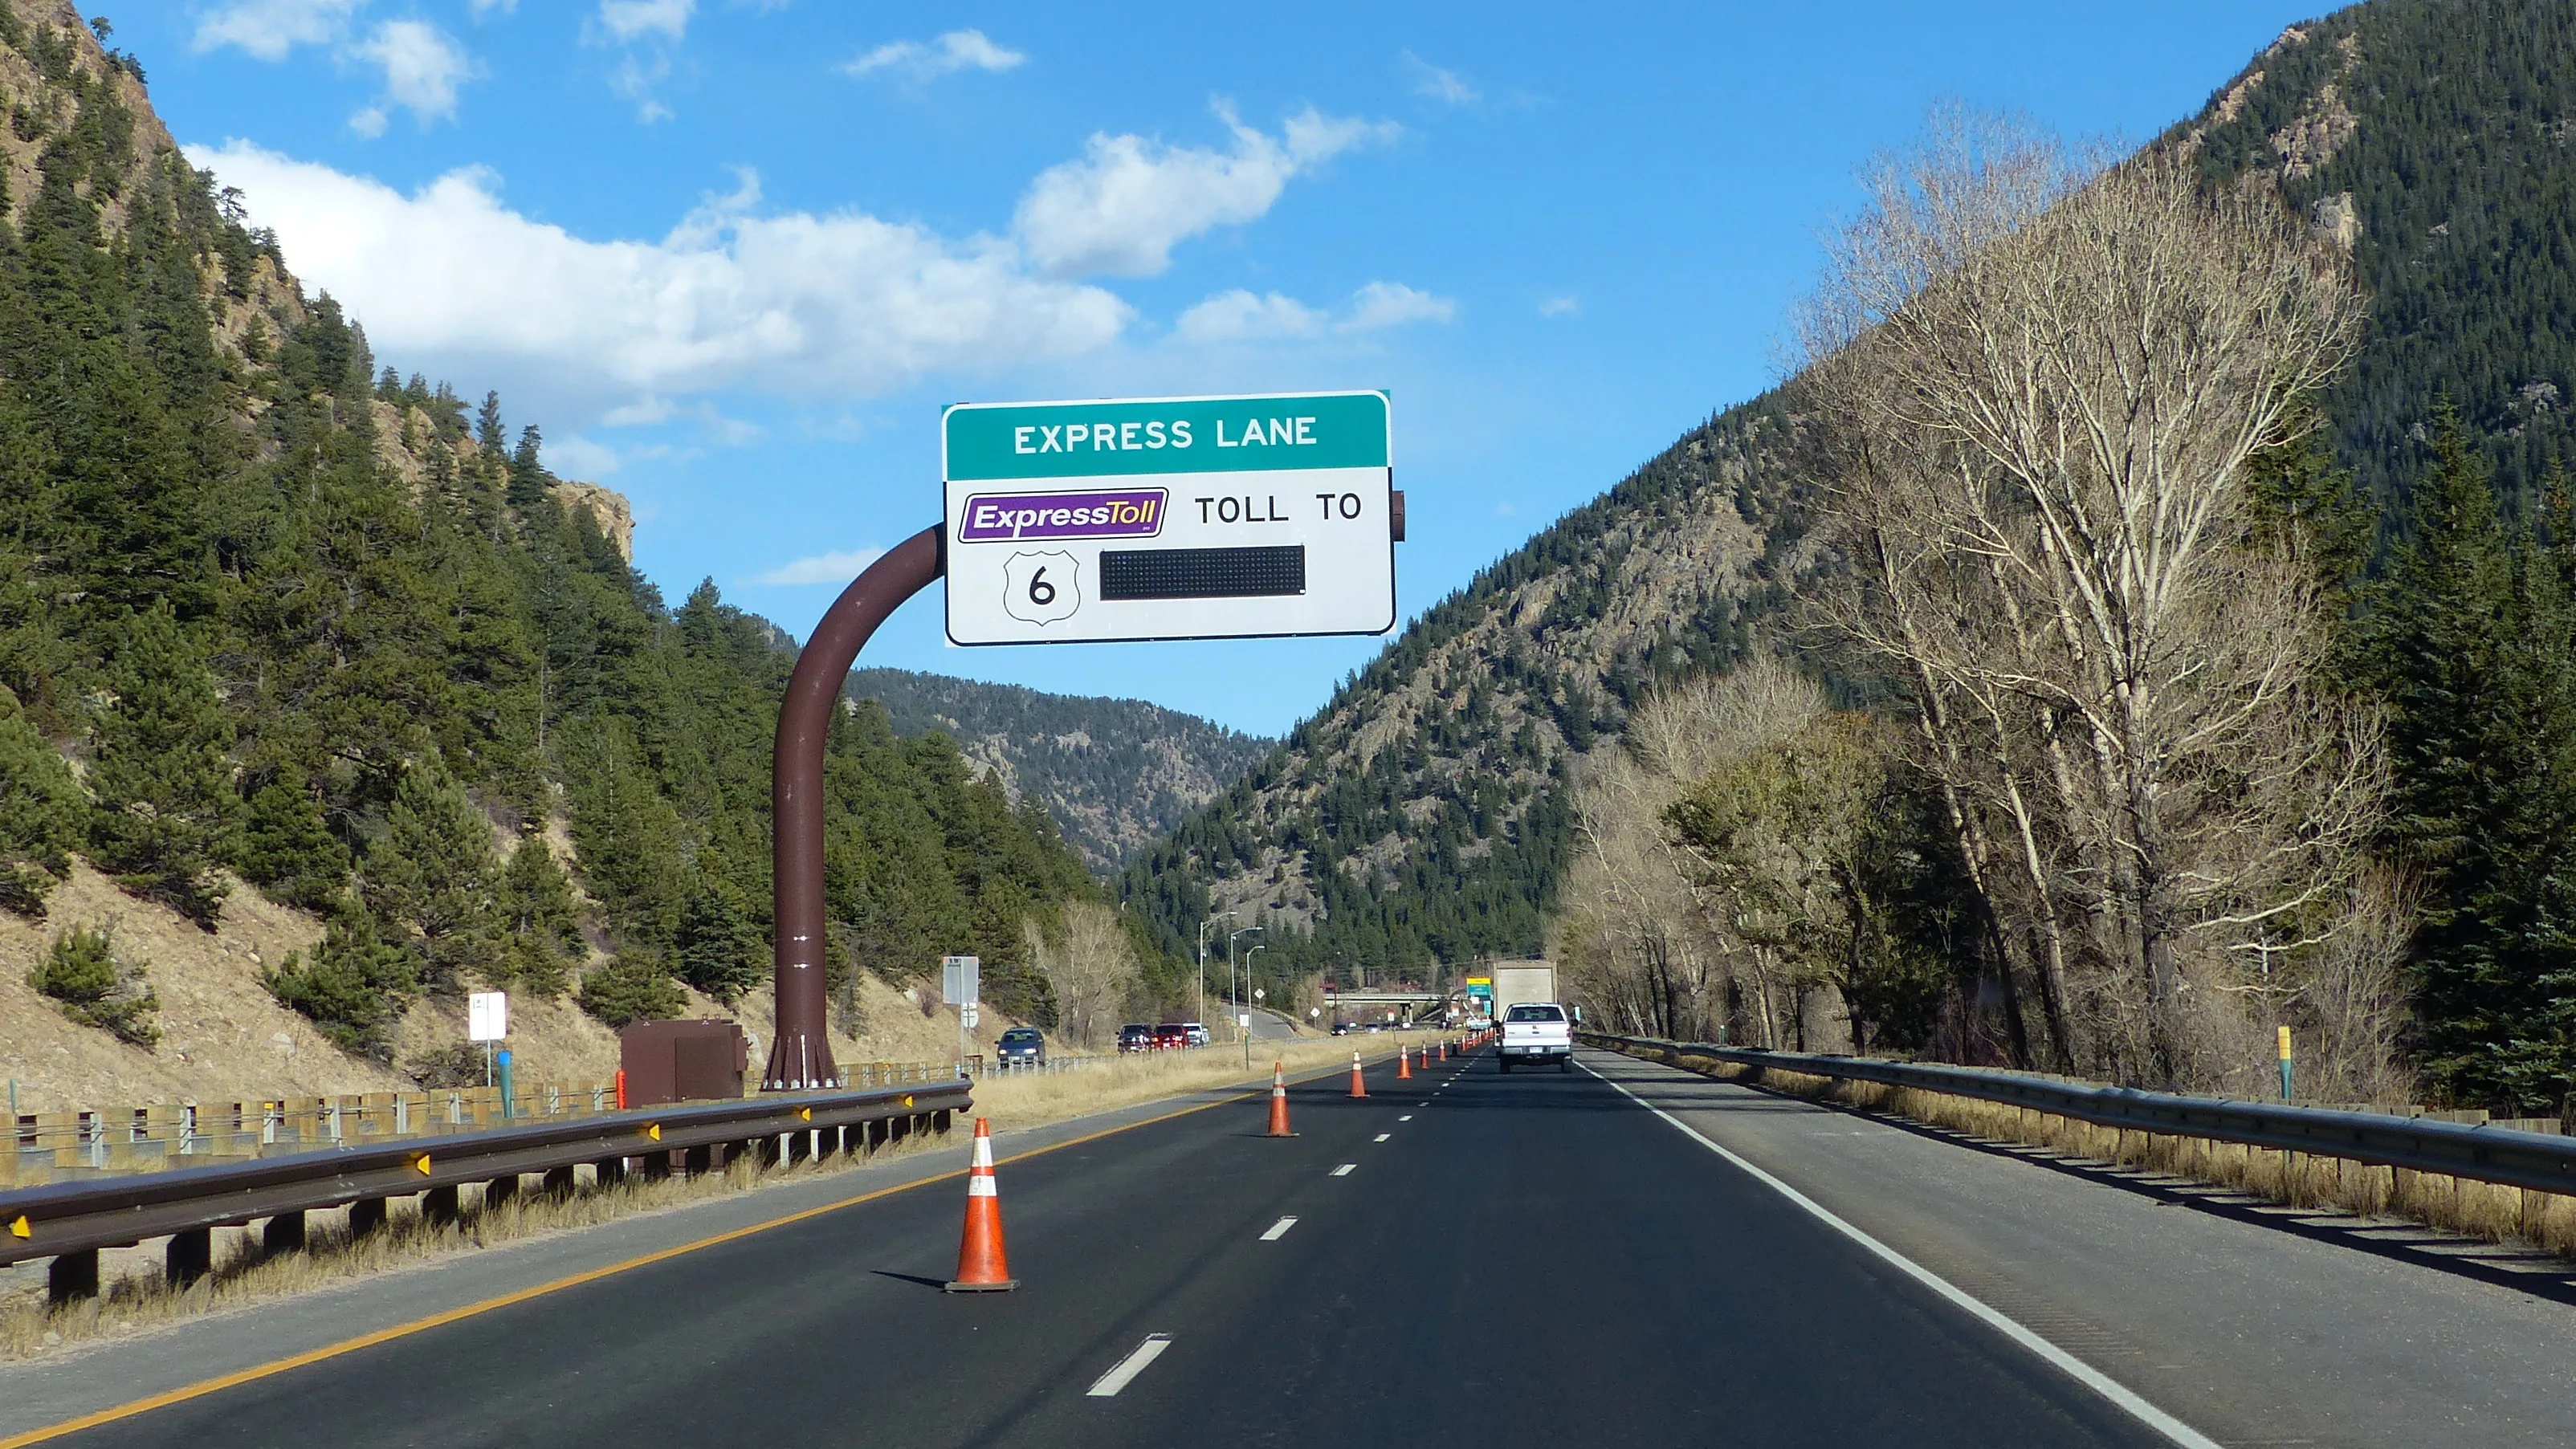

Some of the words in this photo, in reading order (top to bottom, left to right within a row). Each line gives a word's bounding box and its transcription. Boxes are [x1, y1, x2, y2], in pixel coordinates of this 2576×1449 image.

[1014, 420, 1193, 454] EXPRESS
[1217, 417, 1318, 447] LANE
[973, 499, 1156, 538] ExpressToll
[1194, 495, 1290, 524] TOLL
[1315, 492, 1362, 520] TO
[1029, 565, 1057, 606] 6
